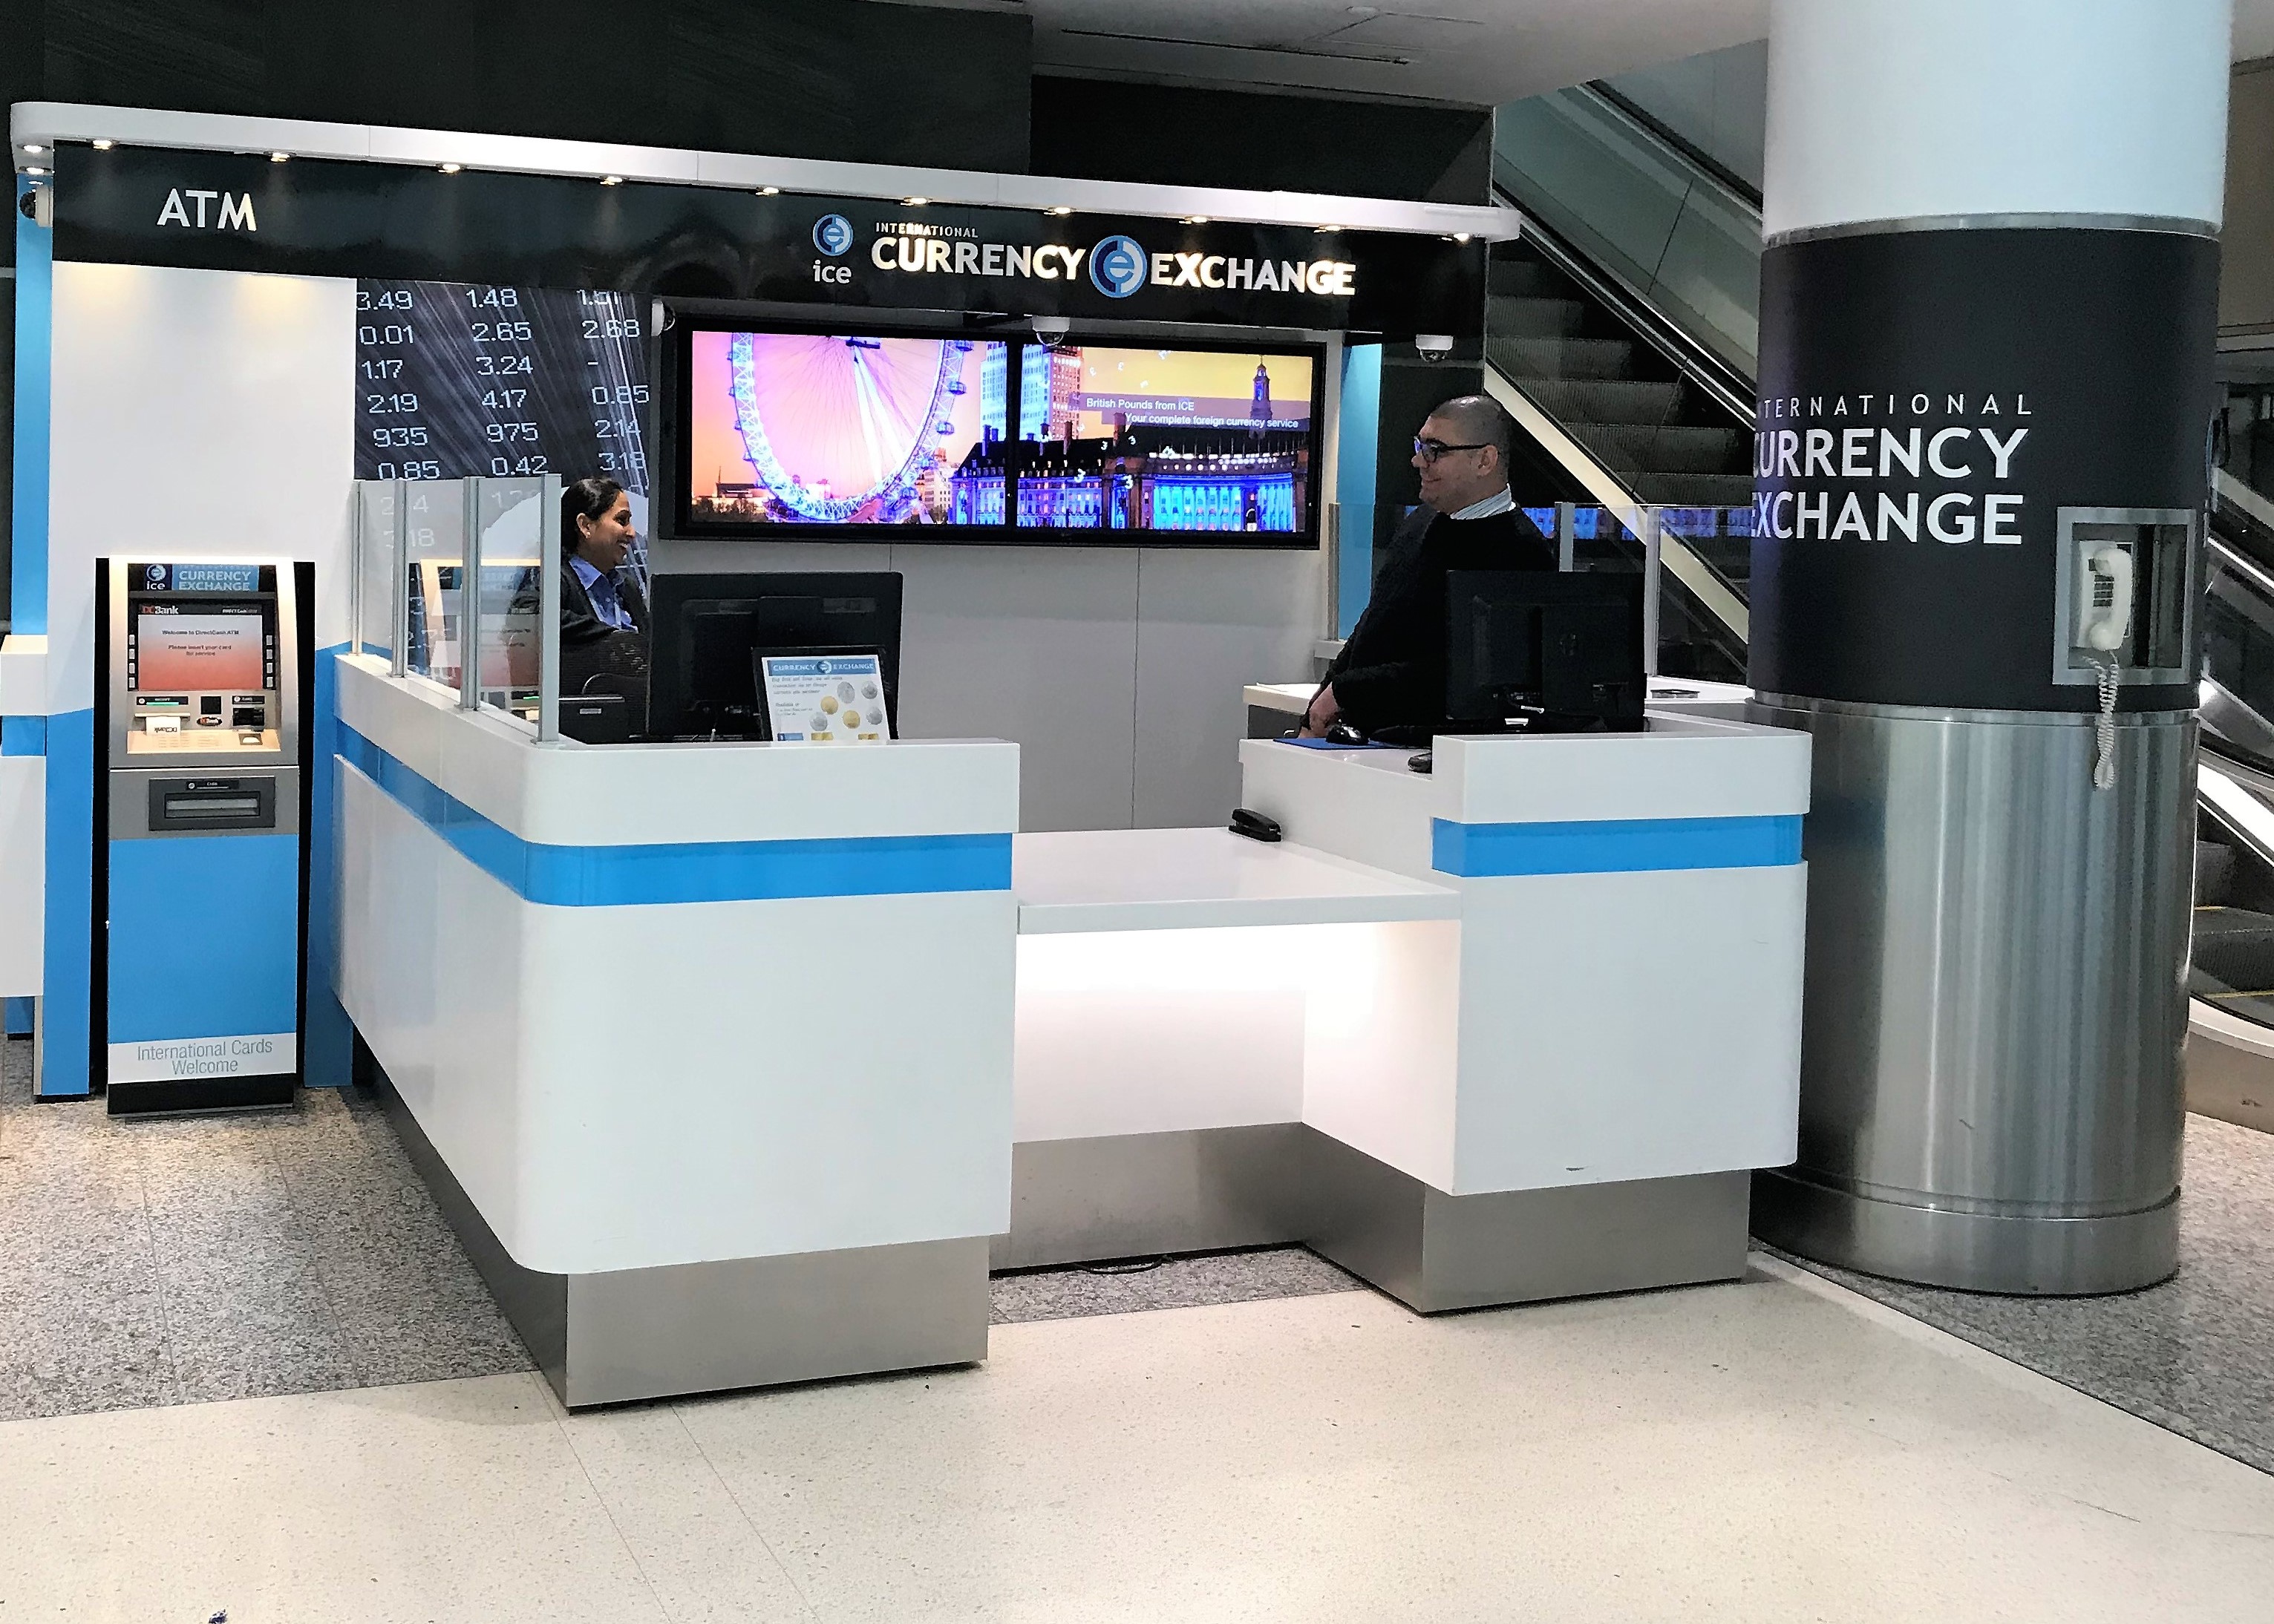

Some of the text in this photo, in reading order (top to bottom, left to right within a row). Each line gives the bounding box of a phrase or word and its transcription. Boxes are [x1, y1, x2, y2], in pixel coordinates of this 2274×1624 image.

[157, 188, 257, 232] ATM
[875, 222, 978, 238] INTERNATIONAL
[813, 260, 852, 284] ice
[872, 237, 1086, 281] CURRENCY
[1151, 252, 1356, 295] EXCHANGE
[356, 291, 413, 311] 3.49
[465, 288, 518, 308] 1.48
[359, 319, 640, 345] 0.01 2.65 2.68
[362, 359, 403, 379] 1.17
[475, 356, 533, 375] 3.24
[367, 384, 650, 413] 2.19 4.17 0.85
[1087, 398, 1195, 410] British Pounds from ICE
[1758, 393, 2032, 419] TERNATIONAL
[1124, 412, 1298, 429] Your complete foreign currency service
[373, 419, 641, 448] 935 975 2.14
[379, 460, 440, 480] 0.85
[491, 456, 549, 476] 0.42
[146, 580, 166, 590] ice
[178, 582, 250, 591] EXCHANGE
[179, 570, 251, 581] CURRENCY
[773, 662, 874, 672] CURRENCY EXCHANGE
[137, 1038, 272, 1061] International Cards
[171, 1058, 238, 1075] Welcome
